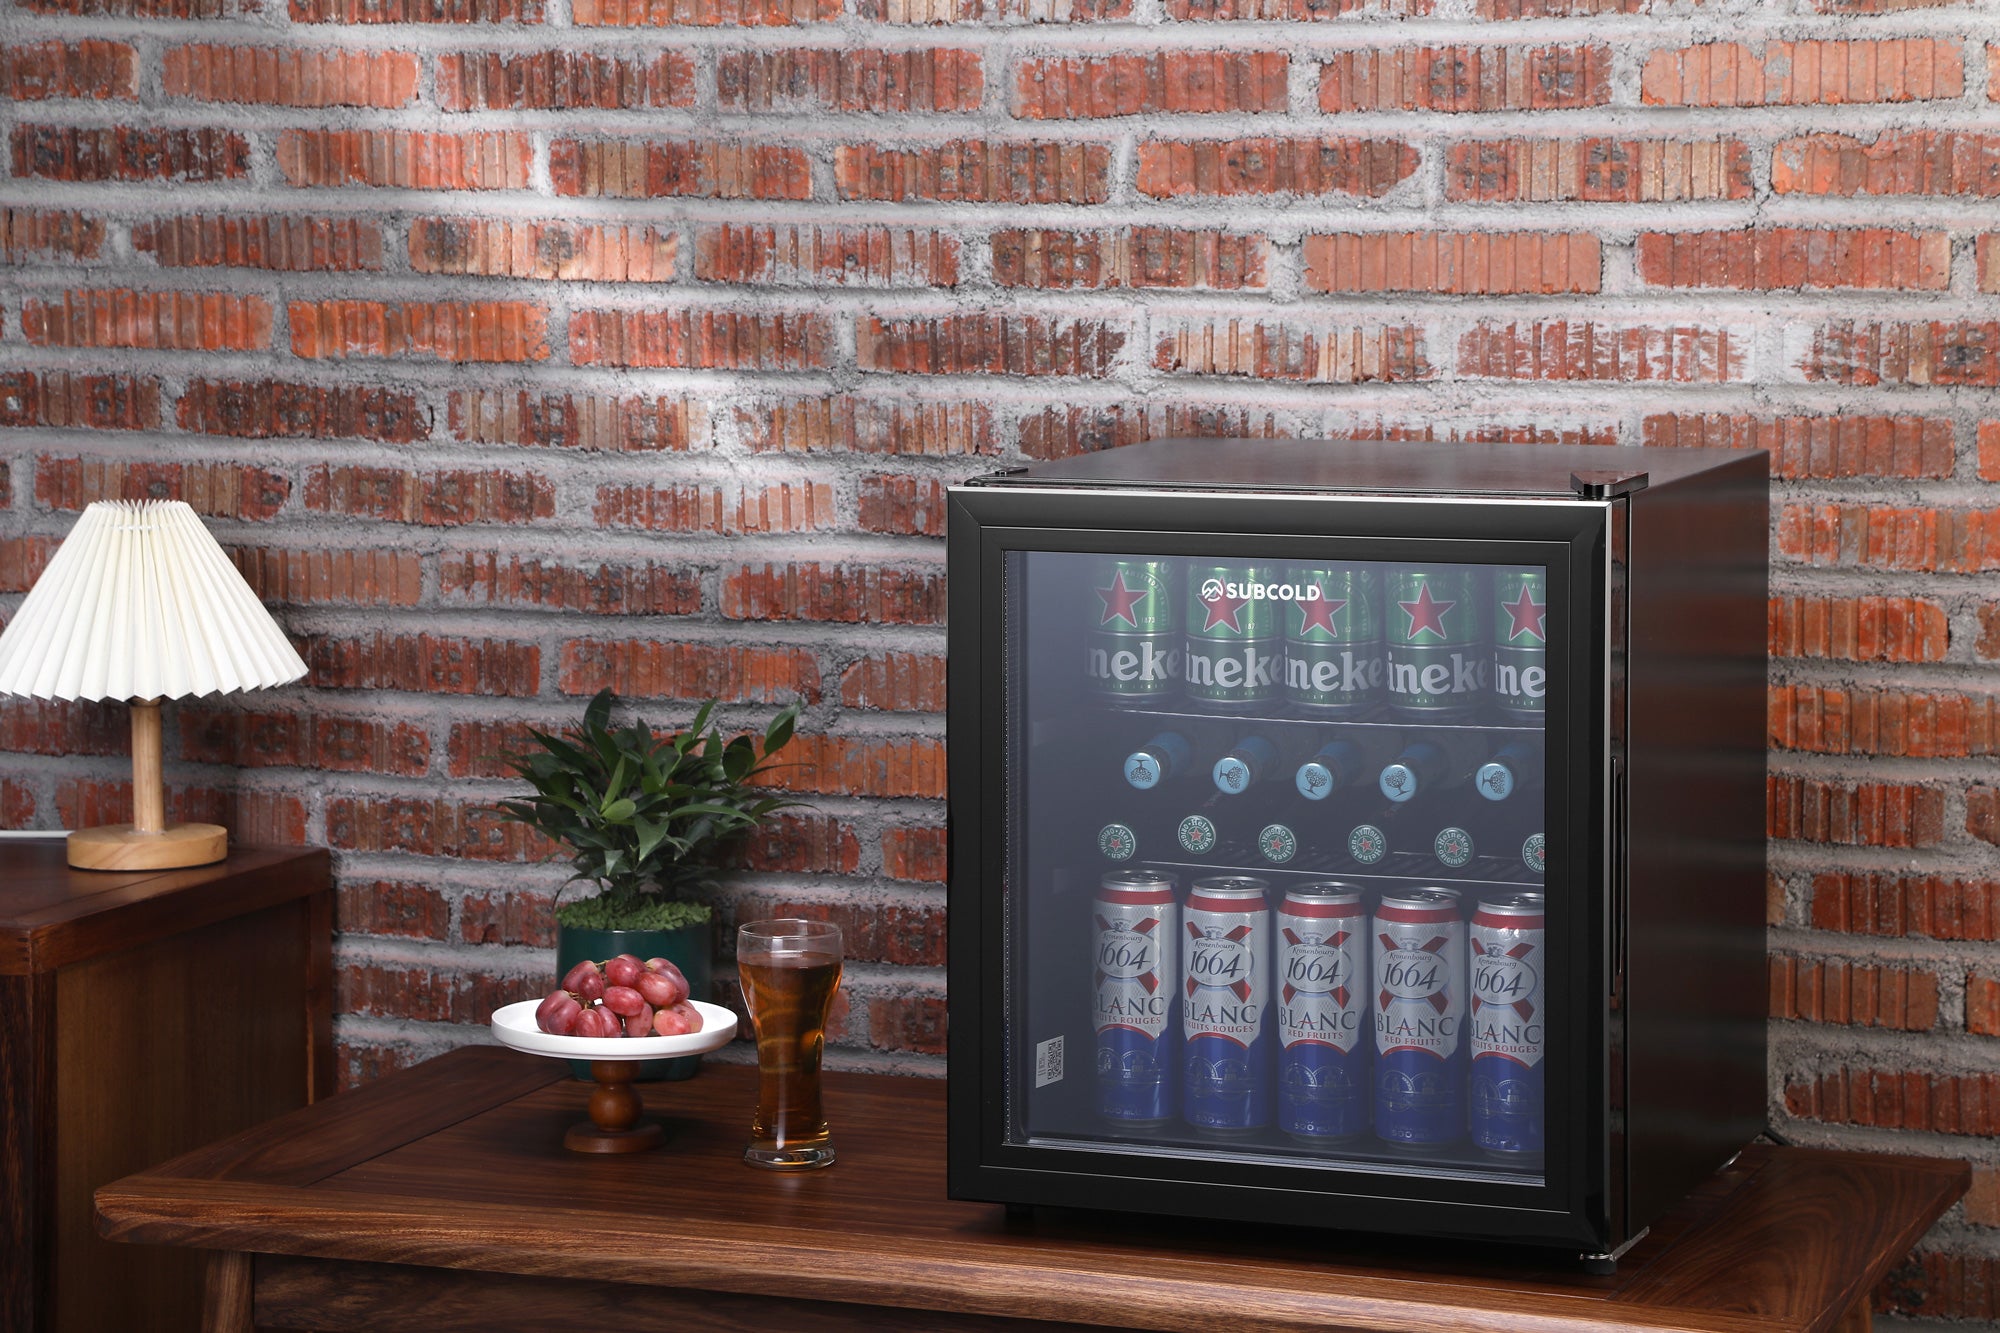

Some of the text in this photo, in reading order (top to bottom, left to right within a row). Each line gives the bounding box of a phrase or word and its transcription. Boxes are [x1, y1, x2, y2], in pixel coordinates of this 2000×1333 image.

[1226, 583, 1320, 601] SUBCOLD
[1098, 940, 1152, 970] 1664
[1190, 948, 1244, 978] 1664
[1287, 955, 1344, 984] 1664
[1383, 961, 1440, 990] 1664
[1474, 965, 1526, 997] 1664
[1096, 1013, 1161, 1025] UITS ROUGES
[1184, 999, 1257, 1024] BLANC
[1280, 1006, 1356, 1031] BLANC
[1213, 1024, 1254, 1033] ROUGES
[1287, 1029, 1344, 1040] RED FRUITS
[1377, 1012, 1454, 1037] BLANC
[1384, 1035, 1441, 1046] RED FRUITS
[1495, 1044, 1538, 1054] ROUGES
